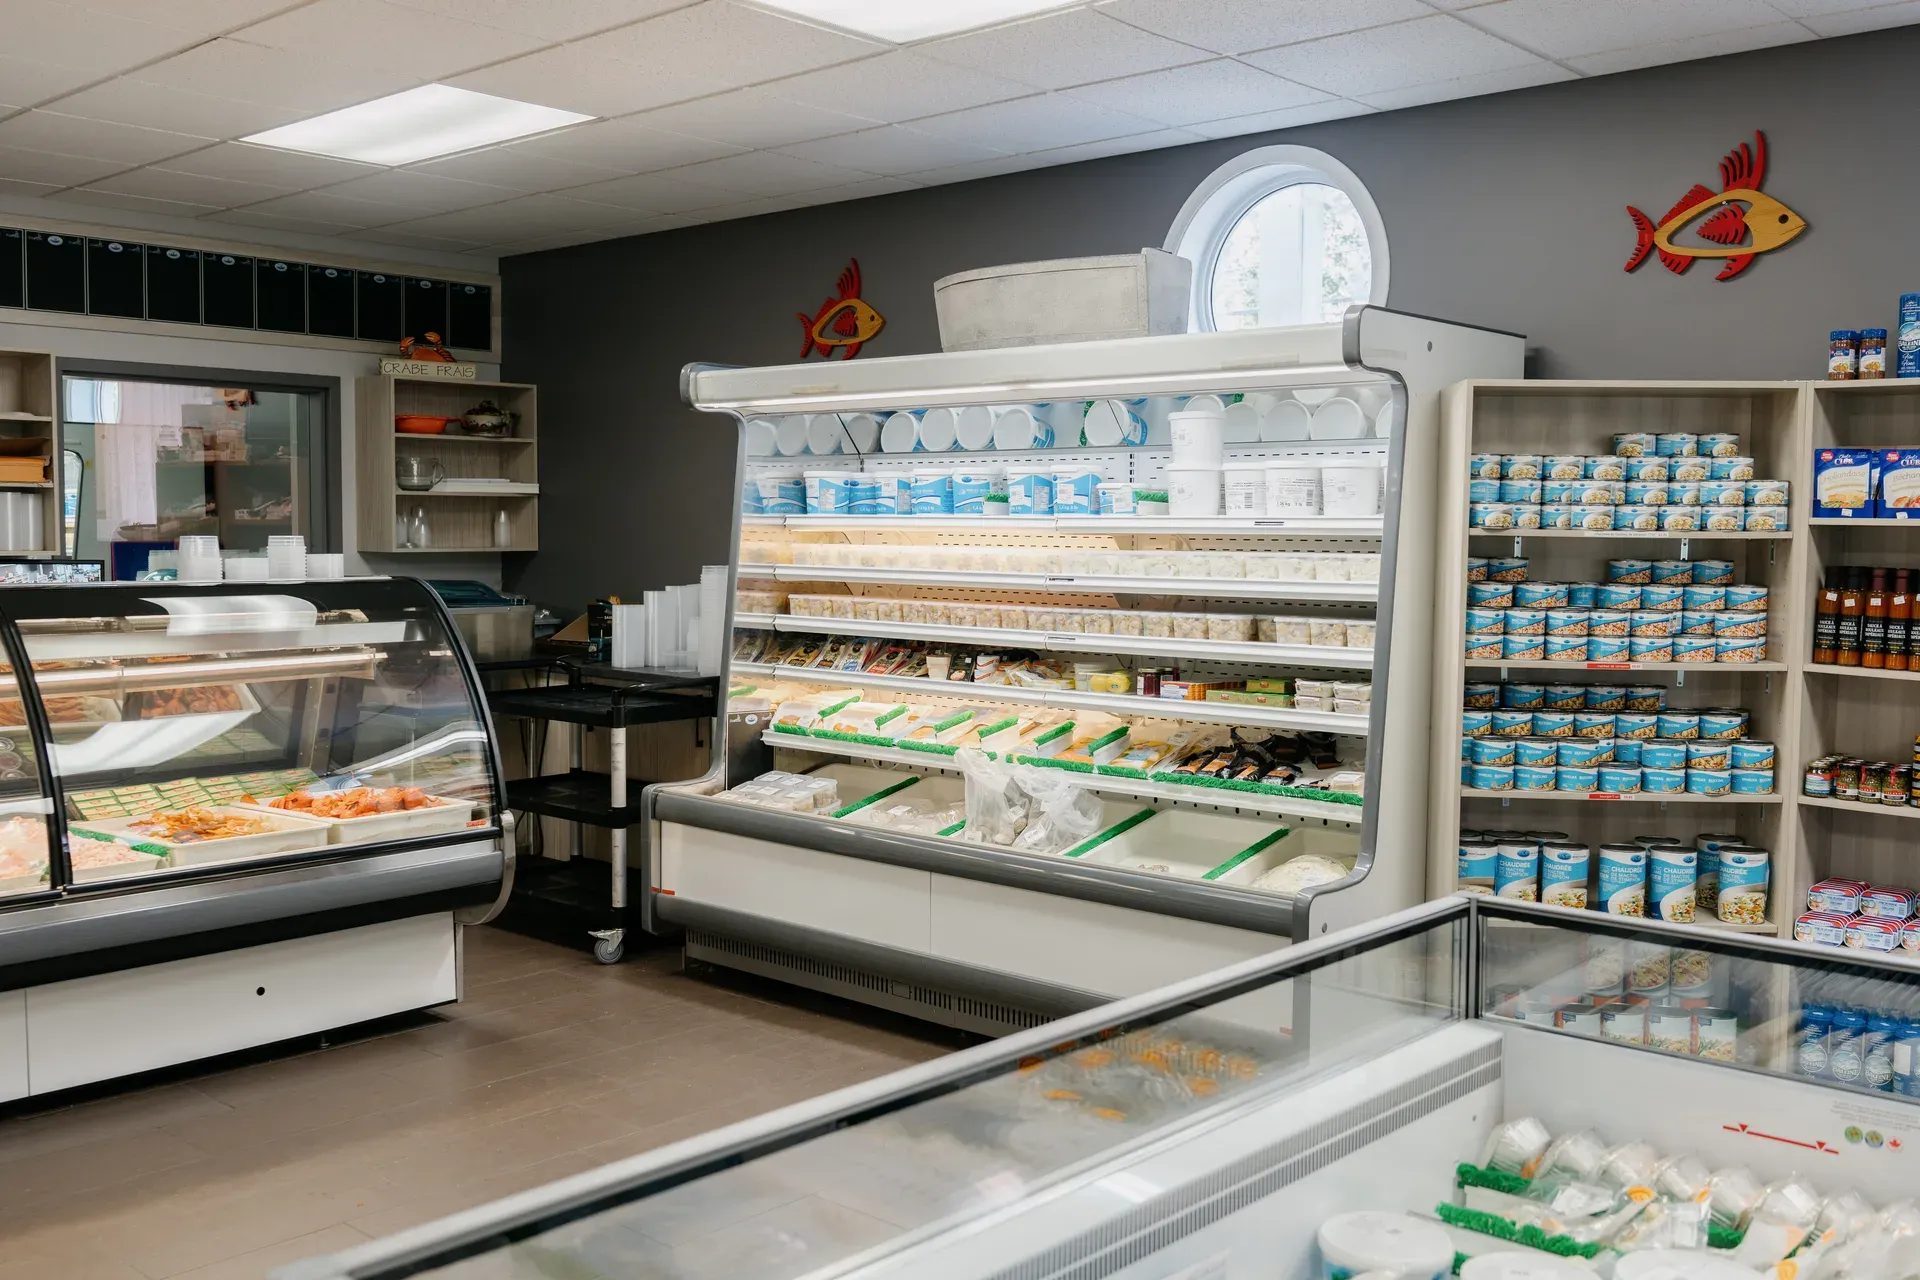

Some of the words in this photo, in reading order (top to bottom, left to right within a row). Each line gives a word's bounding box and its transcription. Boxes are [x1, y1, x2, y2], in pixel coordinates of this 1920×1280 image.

[384, 362, 428, 374] CRABE
[436, 366, 474, 378] FRAIS
[1824, 469, 1865, 482] Hollandaise
